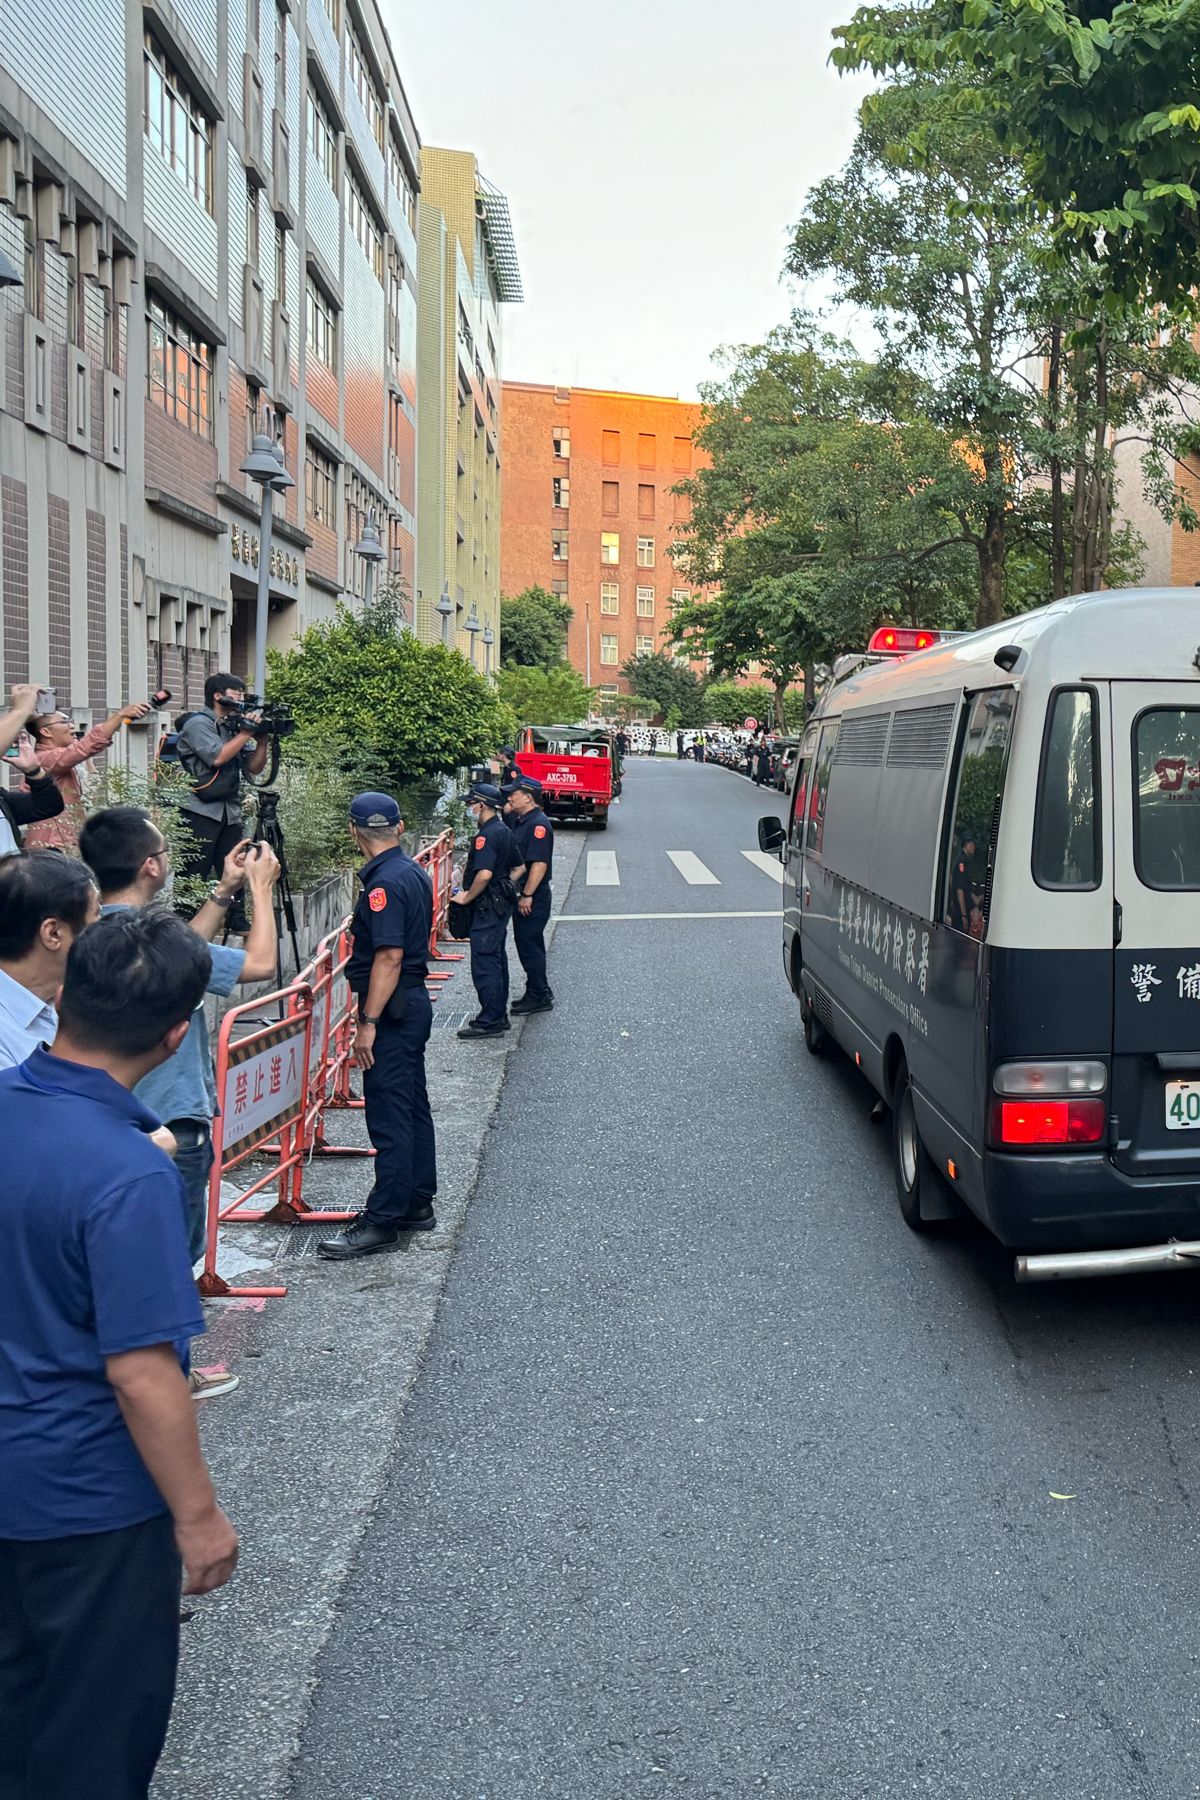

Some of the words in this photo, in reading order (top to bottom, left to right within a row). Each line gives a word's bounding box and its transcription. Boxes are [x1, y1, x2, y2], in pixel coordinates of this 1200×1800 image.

[546, 772, 577, 784] AXC-3793
[838, 885, 930, 997] 臺灣臺北地方檢察署
[909, 1003, 928, 1037] Office
[234, 1047, 297, 1115] 禁止進入
